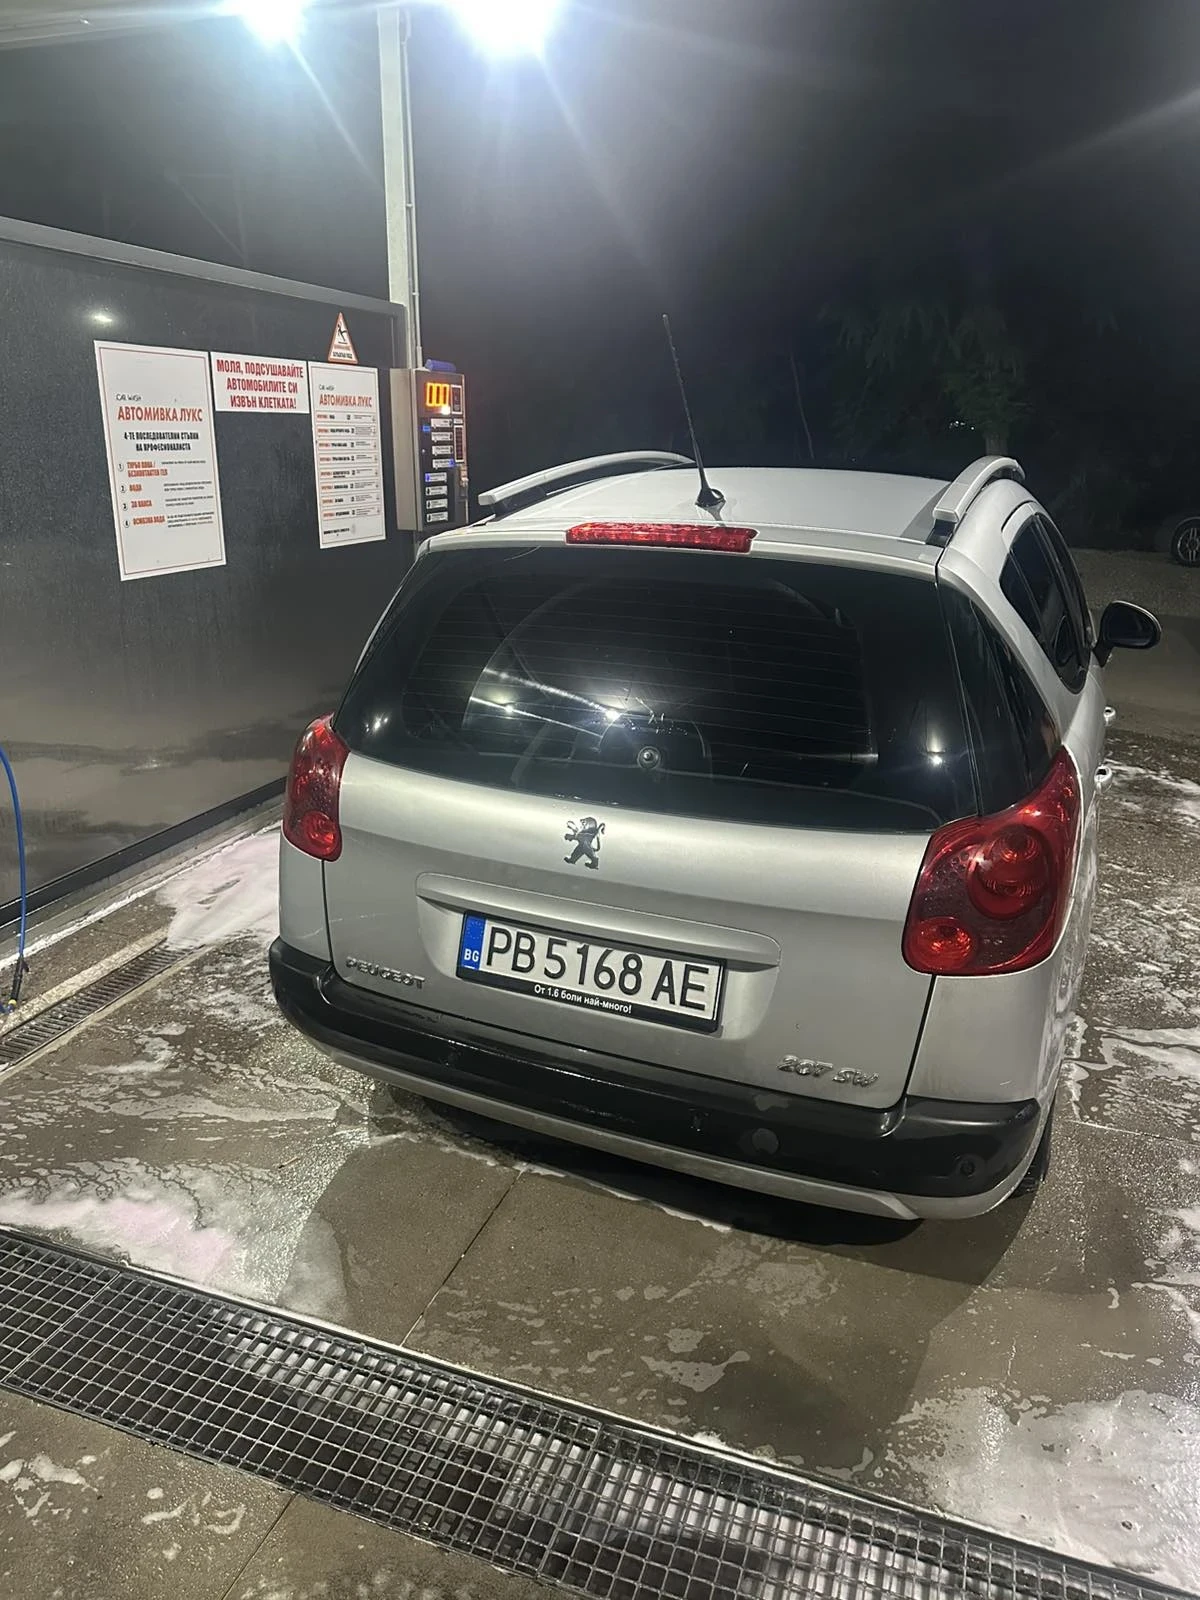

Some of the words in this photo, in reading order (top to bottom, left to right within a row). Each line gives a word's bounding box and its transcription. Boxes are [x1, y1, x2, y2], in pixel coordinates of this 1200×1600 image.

[216, 360, 243, 374] МОЛЯ,
[245, 362, 304, 378] ПОДСУШАВАЙТЕ
[227, 378, 286, 393] АВТОМОБИЛИТЕ
[288, 382, 298, 393] СИ
[230, 395, 257, 408] ИЗВЪН
[258, 397, 296, 409] КЛЕТКАТА!
[320, 394, 356, 407] АВТОМИВКА
[357, 396, 372, 407] ЛУКС
[118, 406, 178, 421] АВТОМИВКА
[180, 408, 203, 422] ЛУКС
[464, 949, 479, 962] BG
[346, 956, 425, 989] PEUGEOT
[486, 926, 536, 974] PB
[544, 938, 642, 996] 5168
[651, 960, 709, 1012] AE
[534, 984, 545, 994] От
[547, 988, 559, 997] 1.6
[561, 990, 582, 1002] боли
[584, 997, 632, 1014] най-много!
[776, 1054, 833, 1077] 207
[832, 1067, 880, 1088] SW
